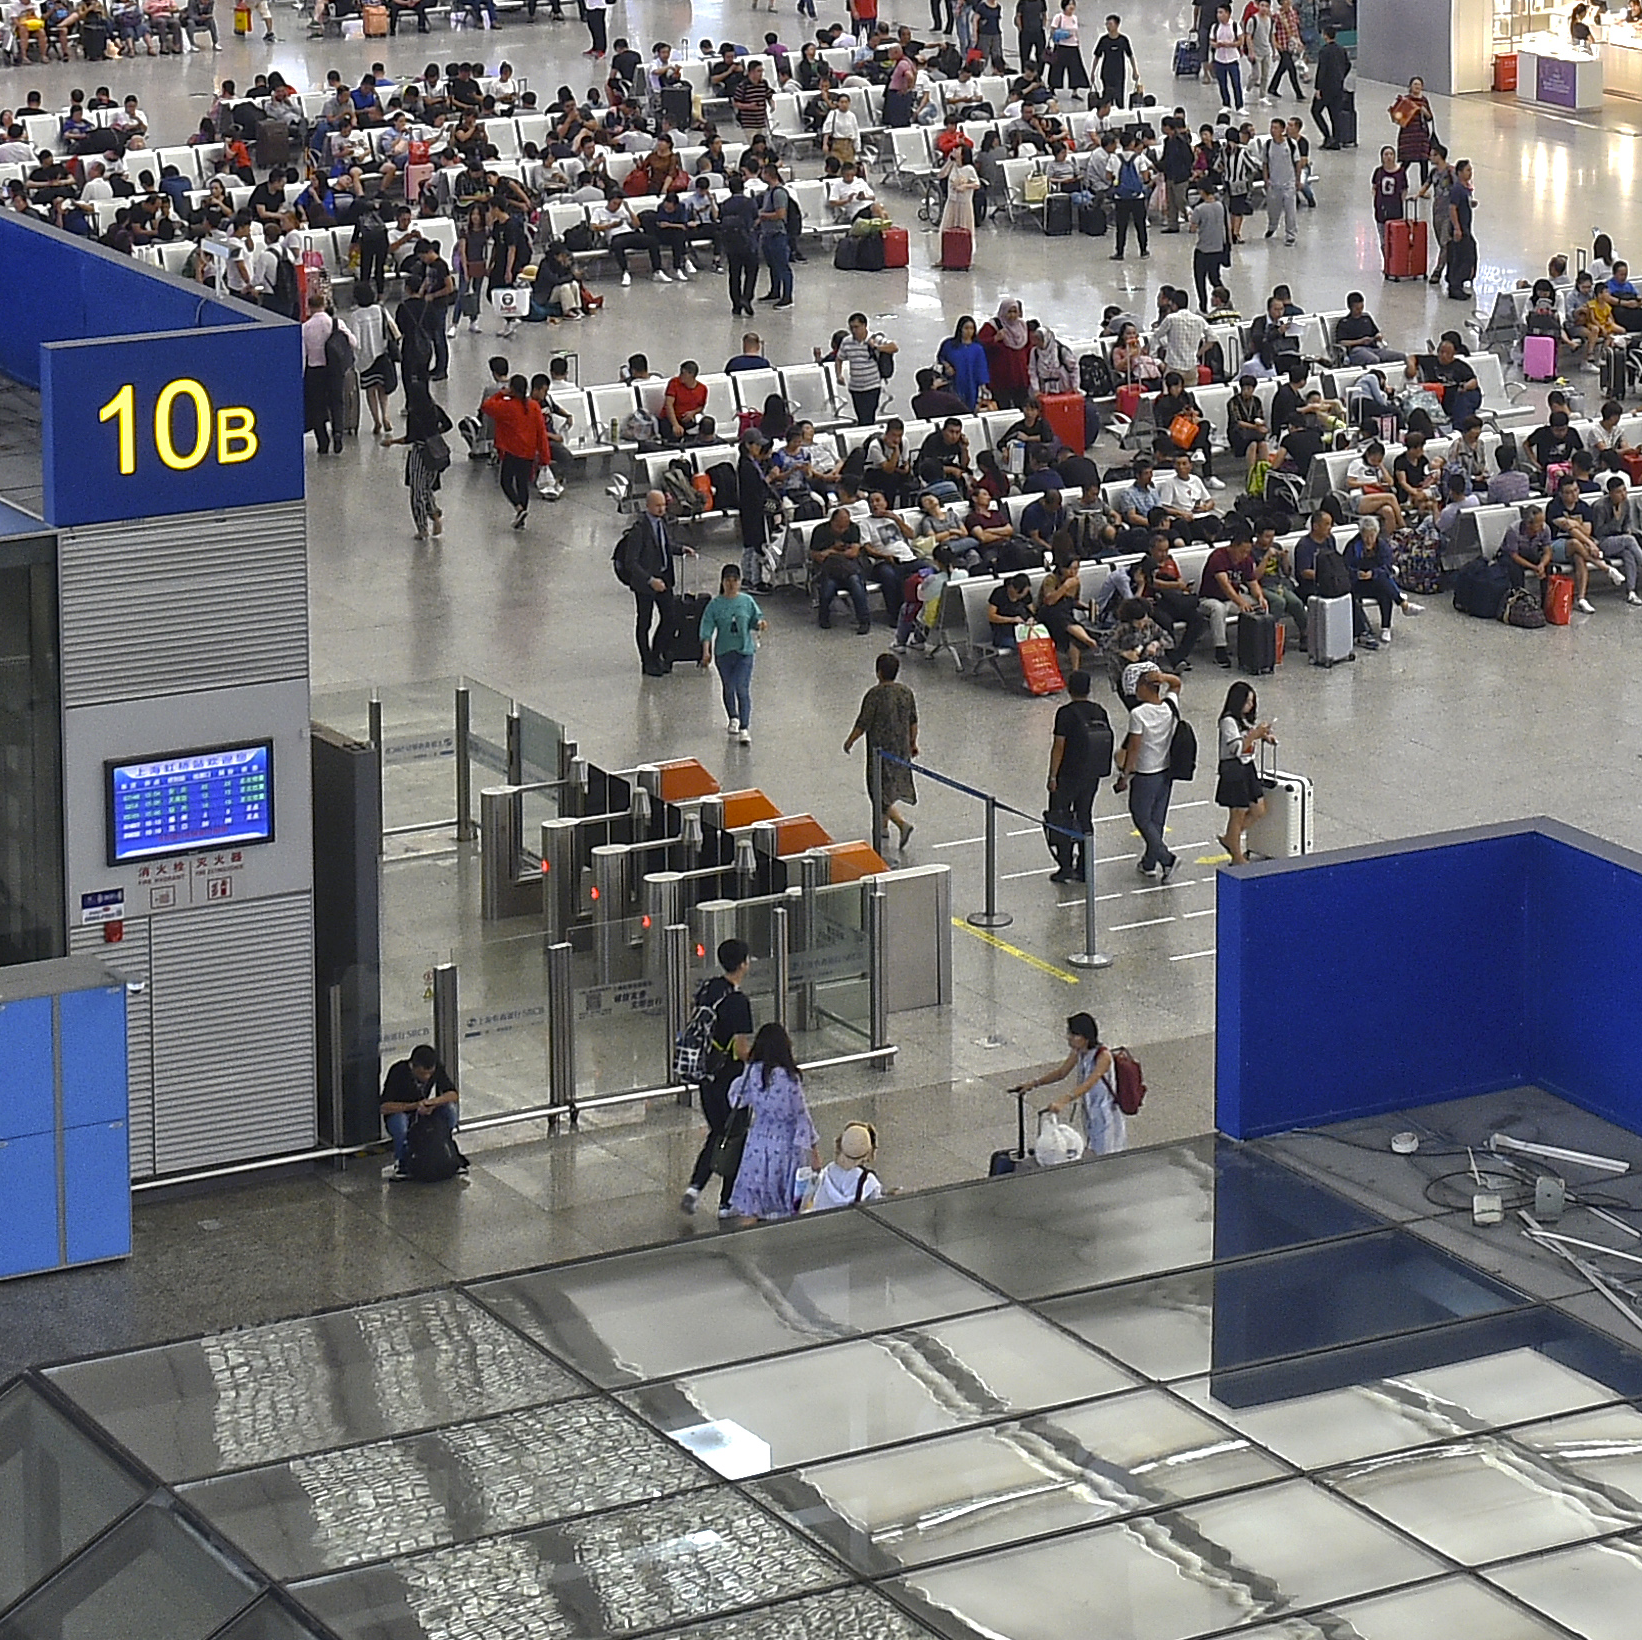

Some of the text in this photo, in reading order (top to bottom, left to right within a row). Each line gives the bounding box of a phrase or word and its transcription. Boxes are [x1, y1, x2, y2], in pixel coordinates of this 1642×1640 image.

[1381, 176, 1396, 196] G
[98, 377, 259, 476] 10B
[196, 852, 243, 868] 灭火器
[139, 861, 185, 878] 消火栓
[155, 874, 185, 883] HYDRANT
